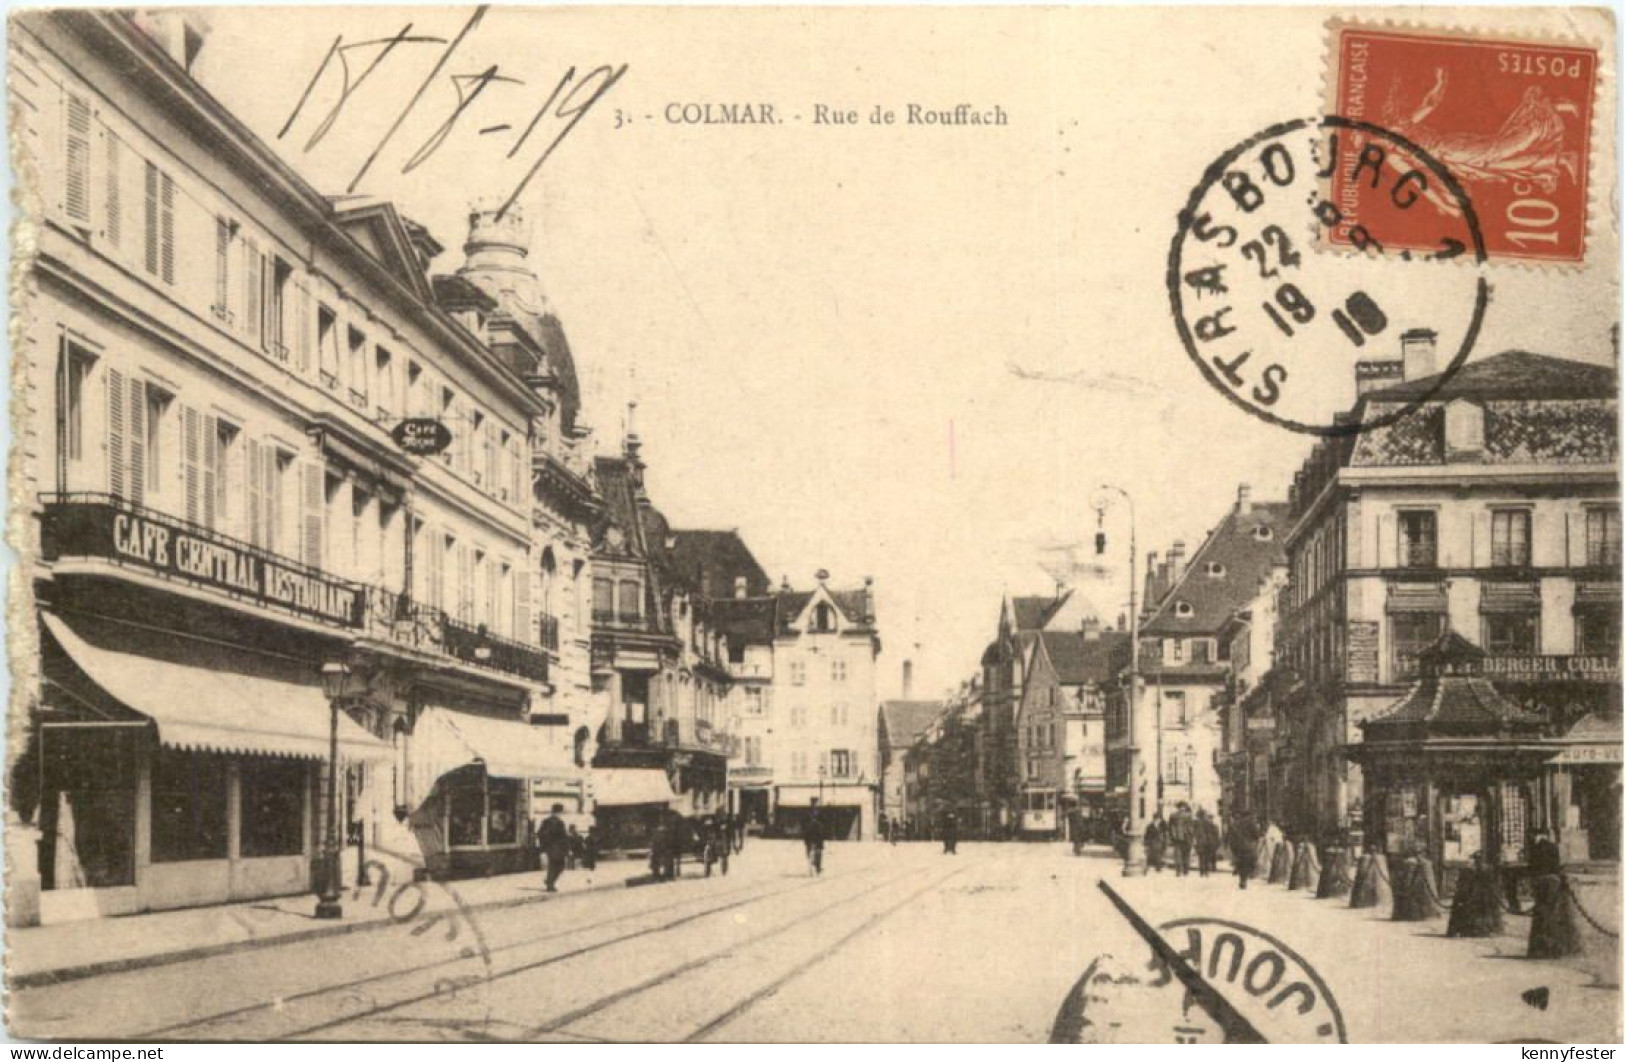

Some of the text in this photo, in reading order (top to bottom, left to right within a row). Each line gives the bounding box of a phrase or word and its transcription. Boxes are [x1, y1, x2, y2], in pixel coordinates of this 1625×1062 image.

[1499, 52, 1581, 78] POSTES
[613, 104, 633, 129] 3.
[664, 103, 784, 125] COLMAR.
[813, 103, 859, 125] Rue
[869, 102, 896, 125] de
[906, 102, 1010, 126] Rouffach
[1184, 134, 1428, 406] STRASBOURG
[1241, 224, 1301, 279] 22
[176, 535, 259, 592] CENTRAL
[264, 562, 354, 622] RESTAURANT
